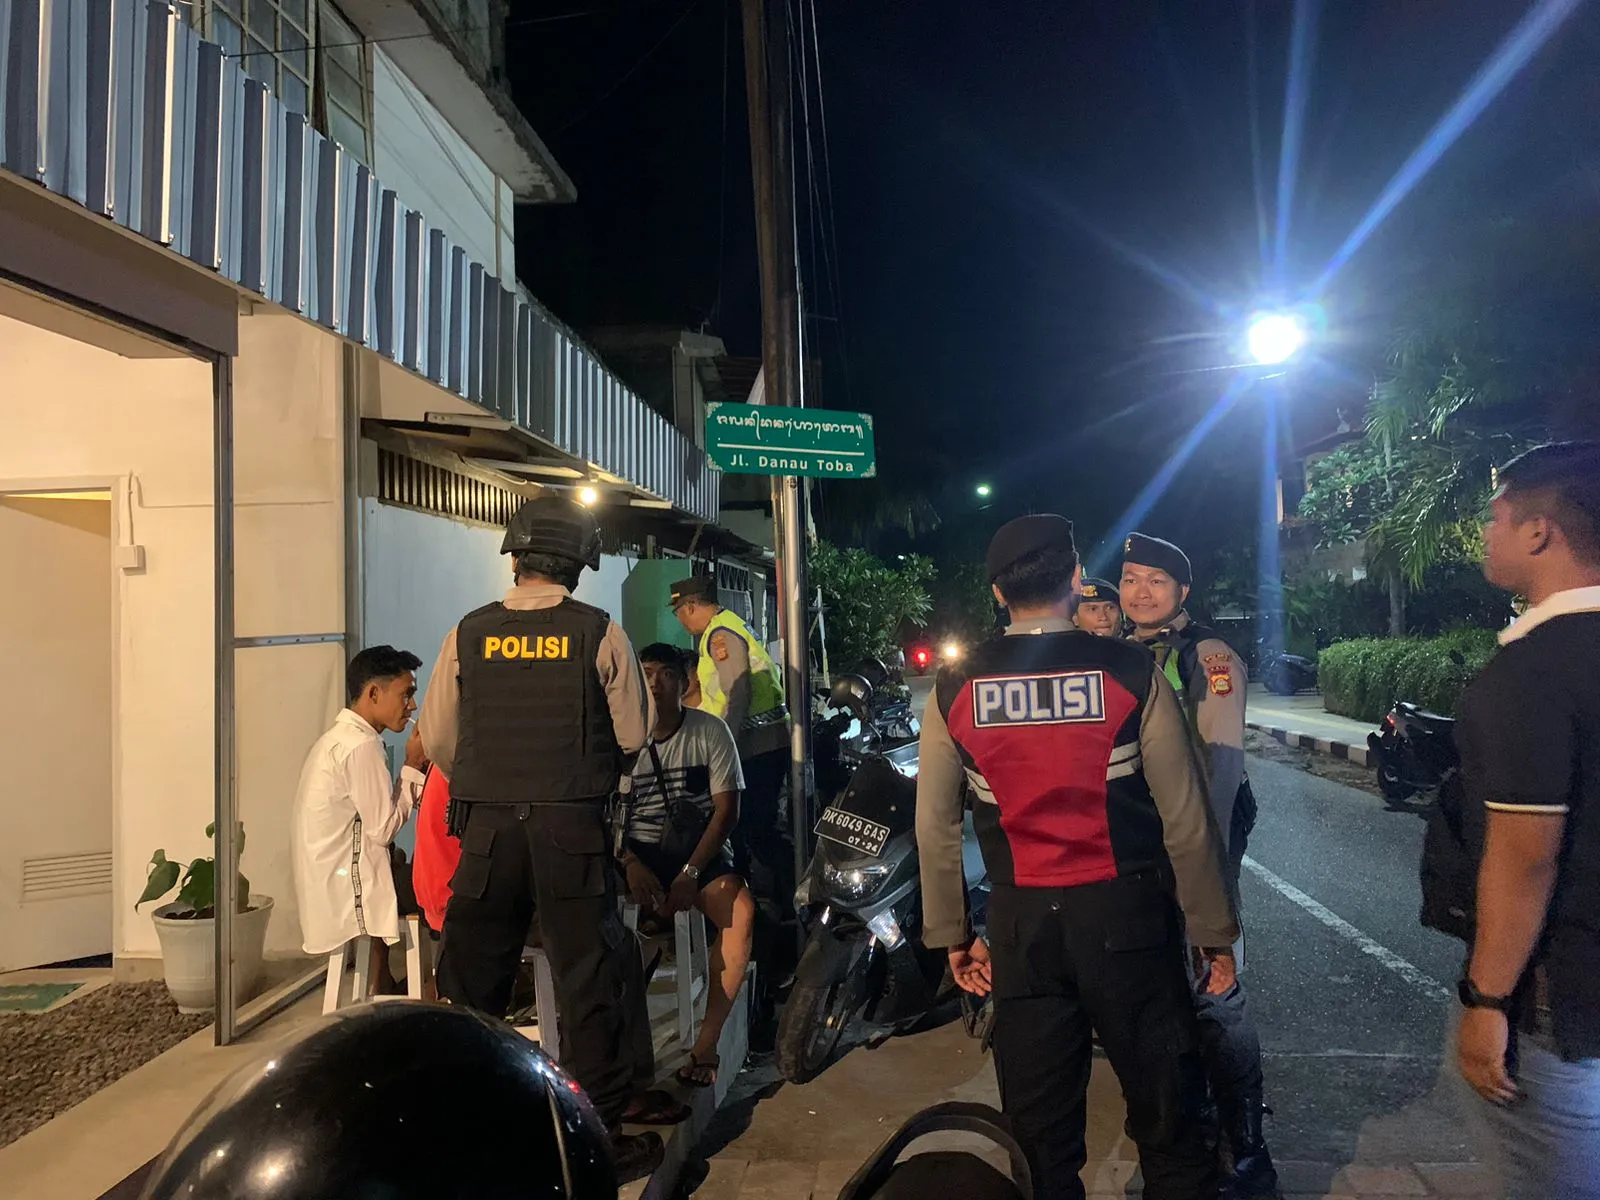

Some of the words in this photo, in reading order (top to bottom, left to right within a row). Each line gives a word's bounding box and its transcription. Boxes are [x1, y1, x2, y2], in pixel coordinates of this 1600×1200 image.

[730, 454, 749, 467] Jl.
[758, 455, 808, 470] Danau
[816, 459, 854, 472] Toba
[484, 636, 569, 659] POLISI
[978, 675, 1100, 722] POLISI
[836, 813, 863, 832] 6049
